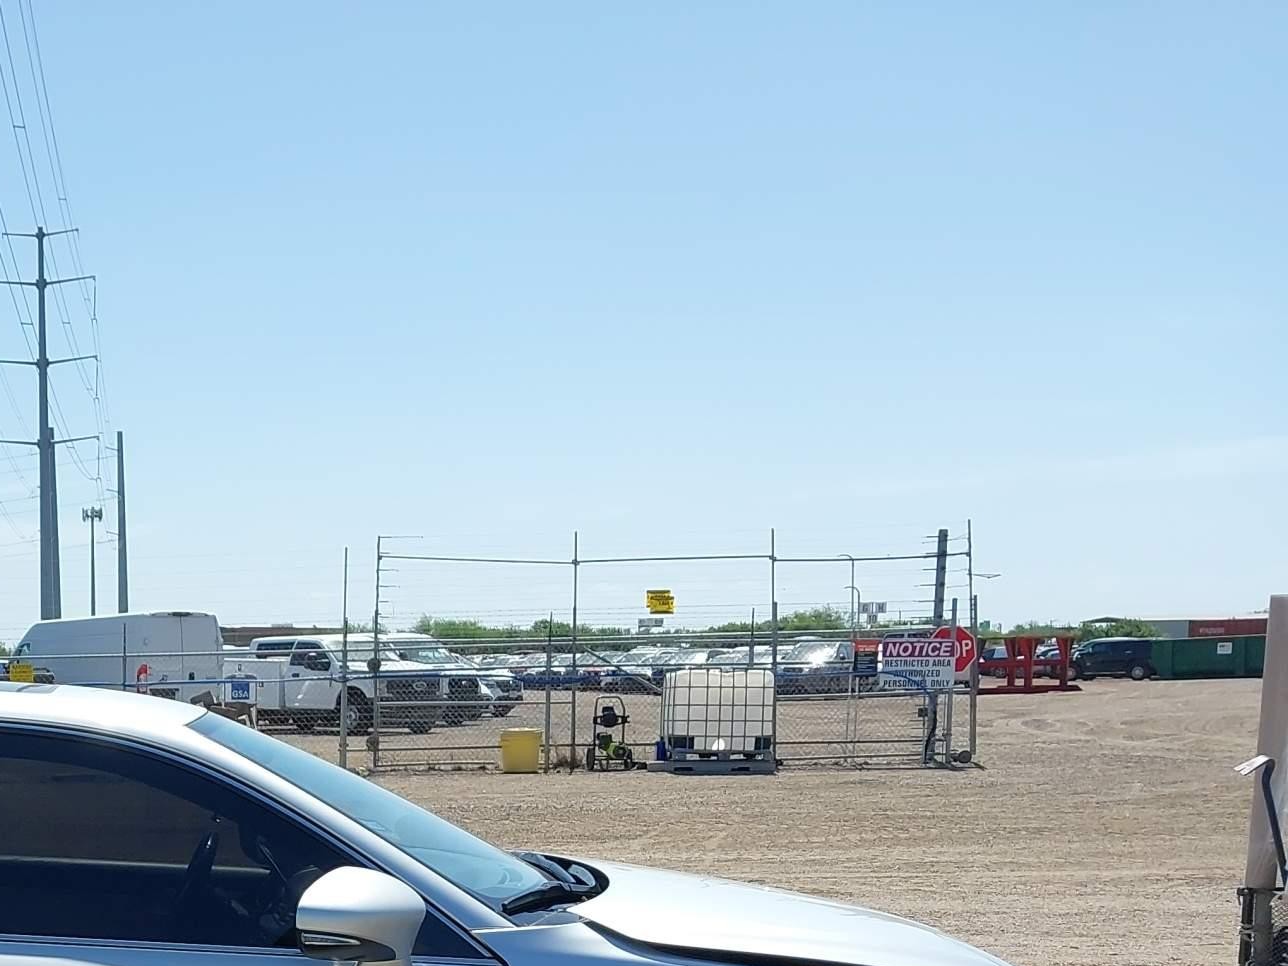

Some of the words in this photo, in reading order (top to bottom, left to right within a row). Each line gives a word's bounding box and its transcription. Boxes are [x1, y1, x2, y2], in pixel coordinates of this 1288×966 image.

[886, 642, 953, 657] NOTICE
[884, 659, 930, 668] RESTRICTED
[932, 659, 951, 667] AREA
[882, 679, 928, 688] PERSONNEL
[930, 679, 951, 688] ONLY
[232, 690, 249, 698] GSA
